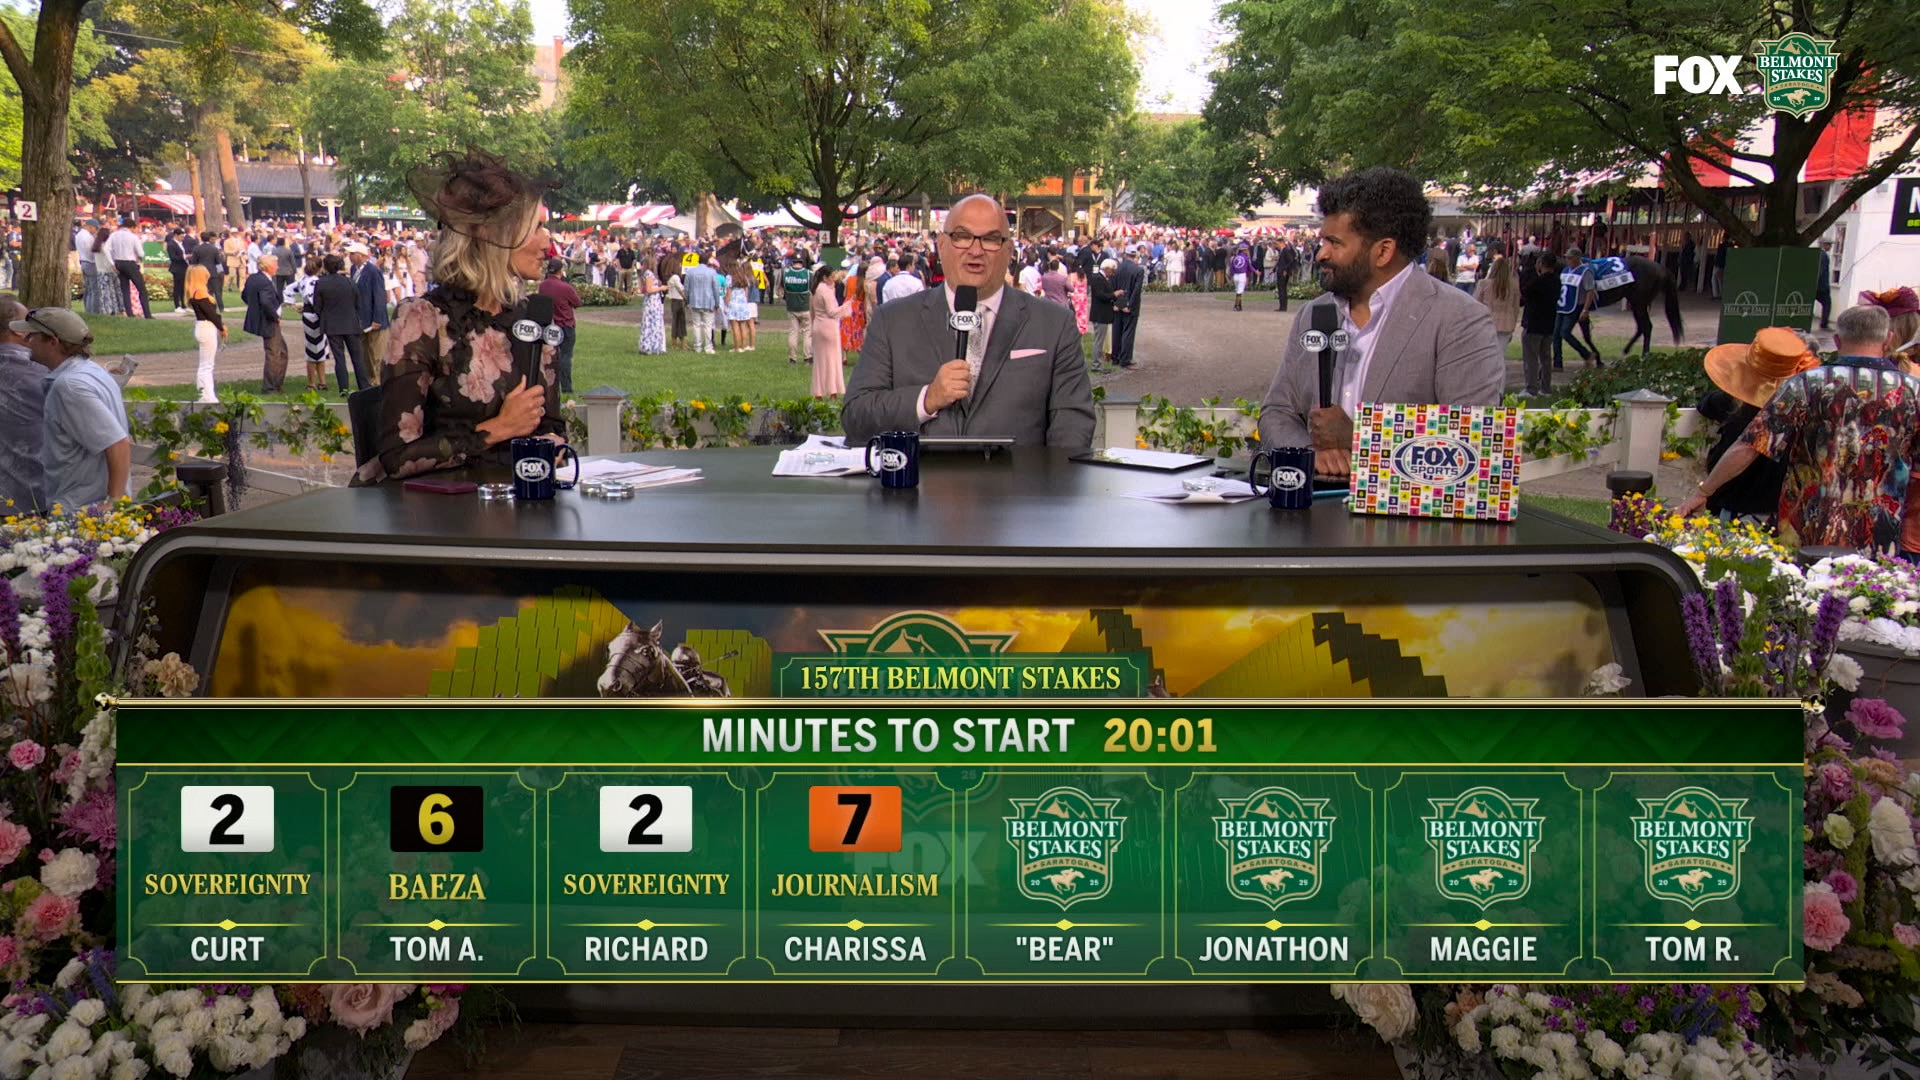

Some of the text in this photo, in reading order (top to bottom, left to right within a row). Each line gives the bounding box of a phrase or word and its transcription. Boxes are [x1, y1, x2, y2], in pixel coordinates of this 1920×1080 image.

[22, 203, 33, 219] 2
[821, 232, 828, 242] 4
[686, 254, 693, 264] 4
[1607, 256, 1624, 272] 3
[785, 276, 807, 284] Nikon
[1557, 285, 1568, 307] 3
[956, 315, 974, 323] FOX
[519, 324, 536, 333] FOX
[548, 328, 560, 337] FOX
[1306, 335, 1322, 344] FOX
[882, 453, 900, 462] FOX
[1411, 446, 1459, 467] FOX
[521, 462, 543, 473] FOX
[1410, 465, 1459, 475] SPORTS
[1276, 471, 1299, 481] FOX
